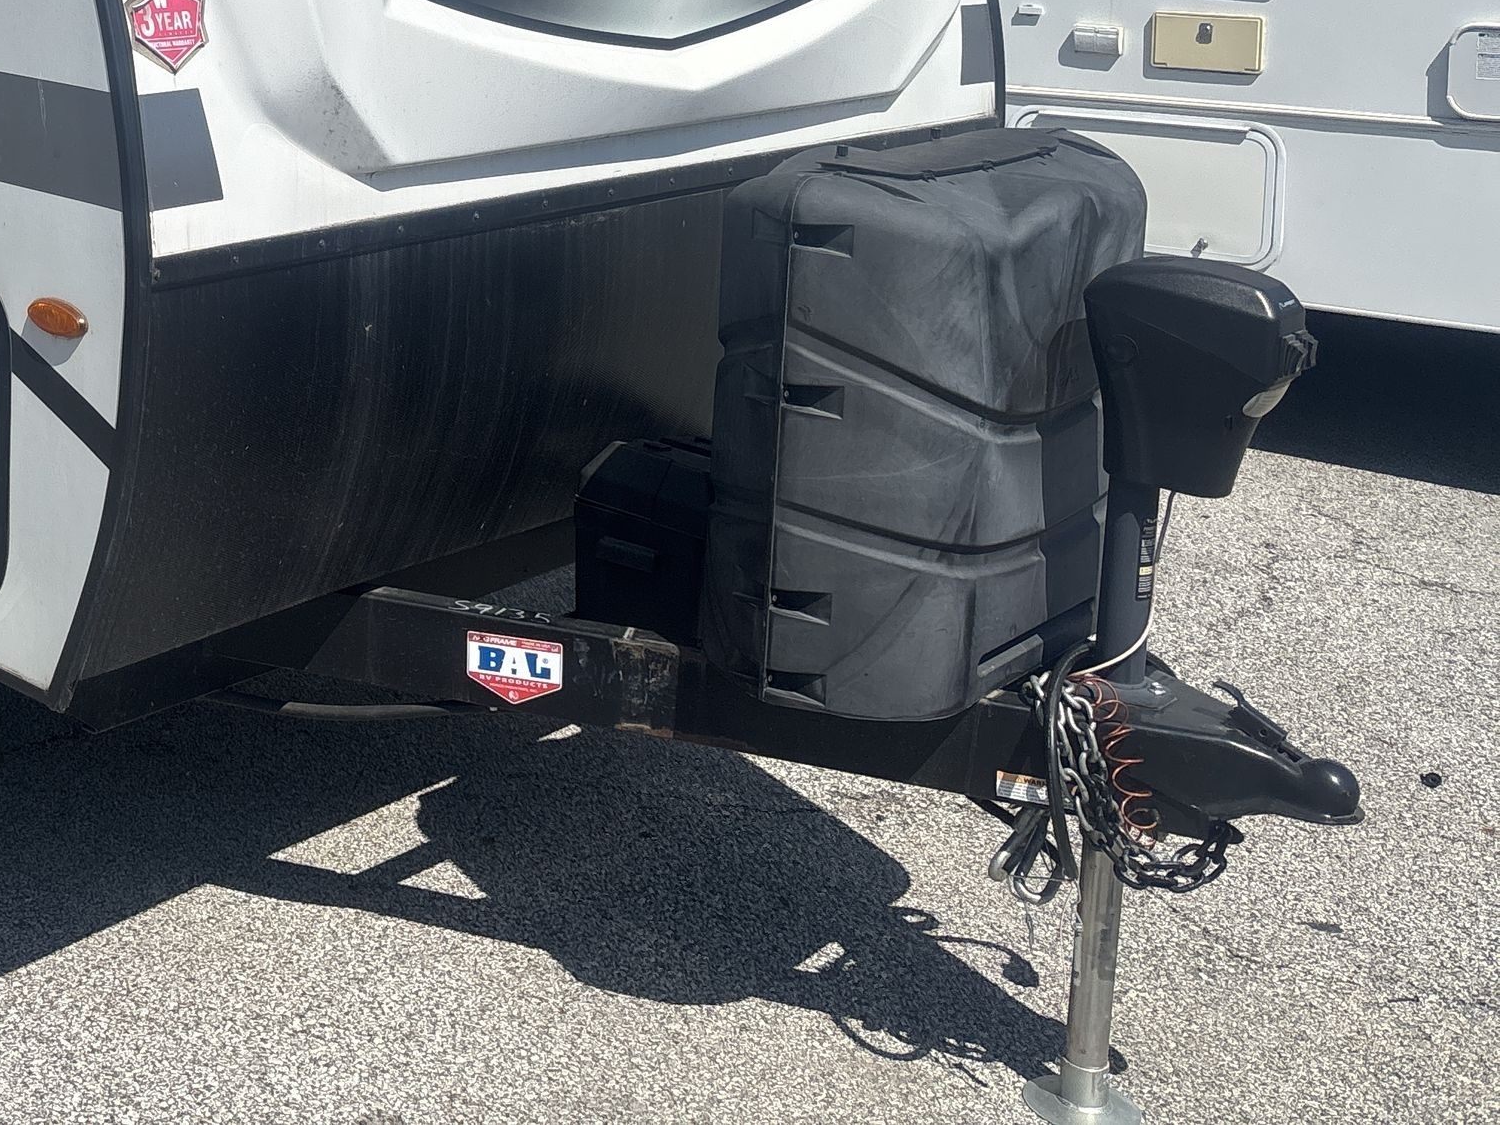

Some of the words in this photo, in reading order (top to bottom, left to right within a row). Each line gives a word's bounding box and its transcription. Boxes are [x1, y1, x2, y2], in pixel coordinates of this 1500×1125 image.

[139, 4, 156, 37] 3
[154, 10, 193, 32] YEAR
[478, 645, 551, 680] BAL
[495, 677, 548, 689] PRODUCTS
